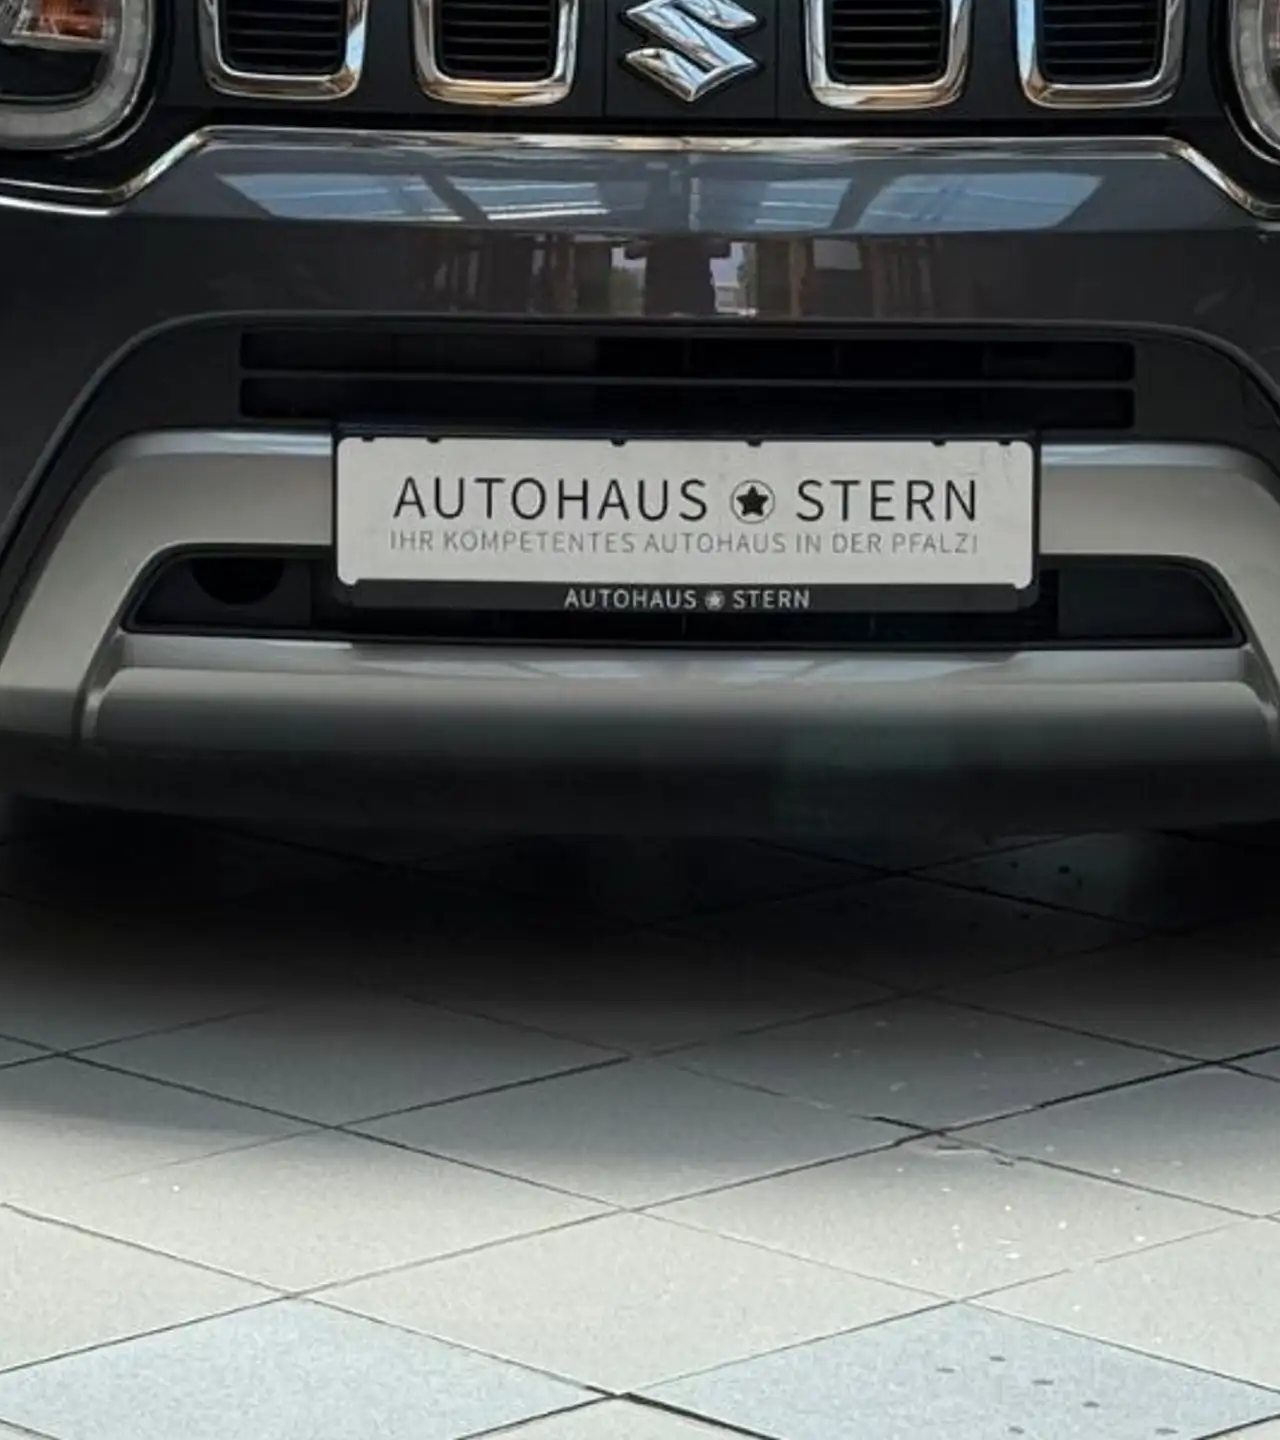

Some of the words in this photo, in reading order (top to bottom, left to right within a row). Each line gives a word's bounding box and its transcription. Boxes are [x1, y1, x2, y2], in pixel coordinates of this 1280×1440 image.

[393, 476, 708, 523] AUTOHAUS
[796, 479, 977, 523] STERN
[389, 529, 434, 552] IHR
[443, 531, 636, 554] KOMPETENTES
[644, 533, 786, 555] AUTOHAUS
[795, 533, 821, 555] IN
[832, 533, 883, 555] DER
[563, 589, 697, 609] AUTOHAUS
[733, 590, 810, 610] STERN
